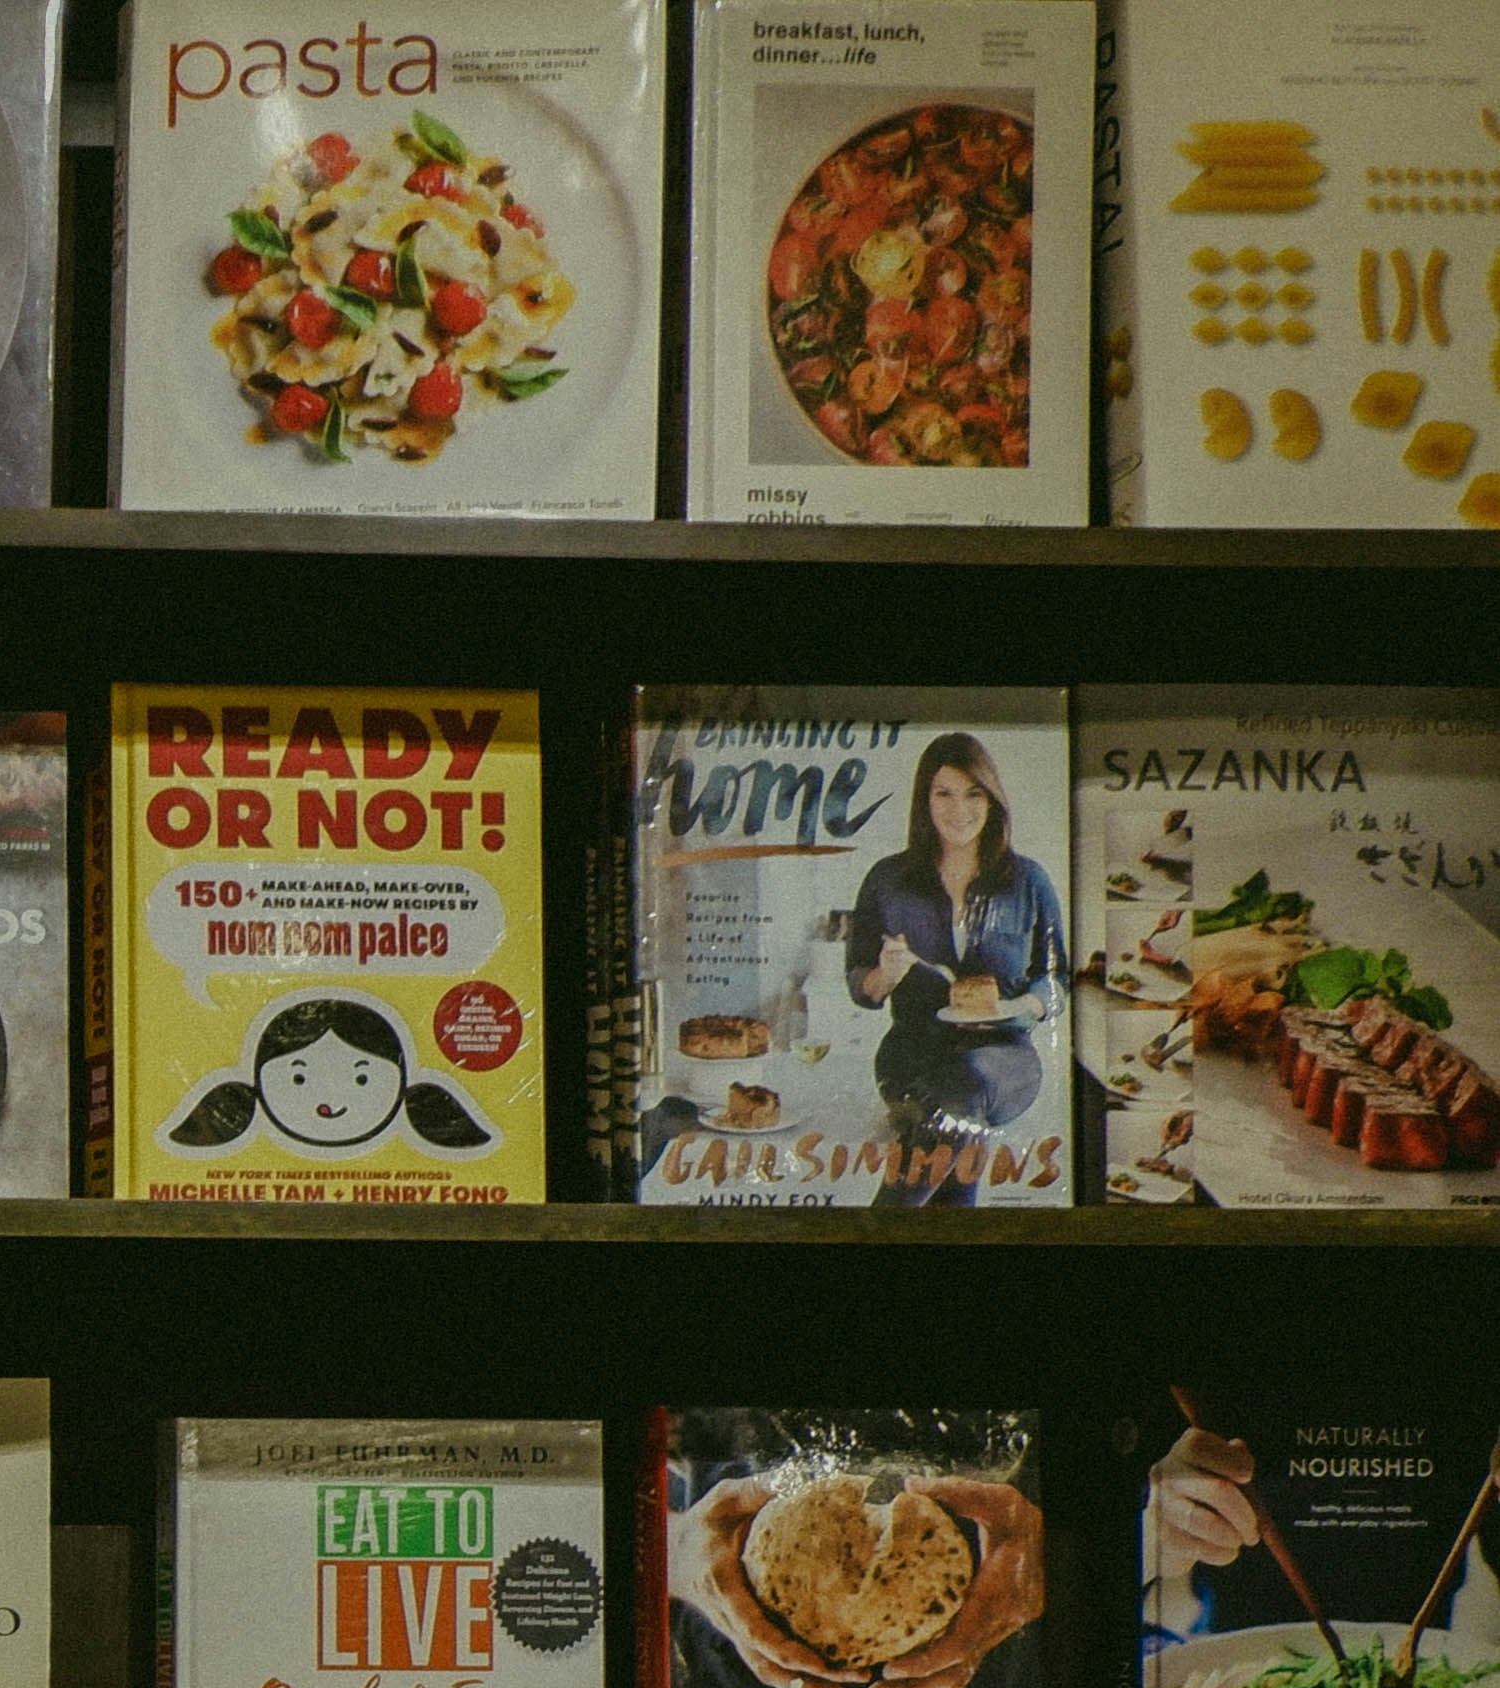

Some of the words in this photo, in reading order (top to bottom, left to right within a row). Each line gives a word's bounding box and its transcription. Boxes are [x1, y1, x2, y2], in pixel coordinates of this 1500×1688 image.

[753, 20, 858, 43] breakfast,
[862, 22, 926, 43] lunch,
[169, 20, 437, 127] pasta
[147, 707, 502, 780] READY
[1103, 748, 1368, 794] SAZANKA
[147, 788, 274, 852] OR
[297, 789, 506, 852] NOT!
[261, 879, 369, 895] MAKE-AHEAD,
[373, 880, 470, 897] MAKE-OVER,
[262, 896, 295, 910] AND
[300, 897, 389, 910] MAKE-NOW
[394, 897, 454, 910] RECIPES
[459, 897, 478, 910] BY
[1296, 1426, 1426, 1447] NATURALLY
[1288, 1457, 1434, 1479] NOURISHED
[324, 1491, 409, 1555] EAT
[417, 1488, 490, 1553] TO
[321, 1564, 492, 1668] LIVE
